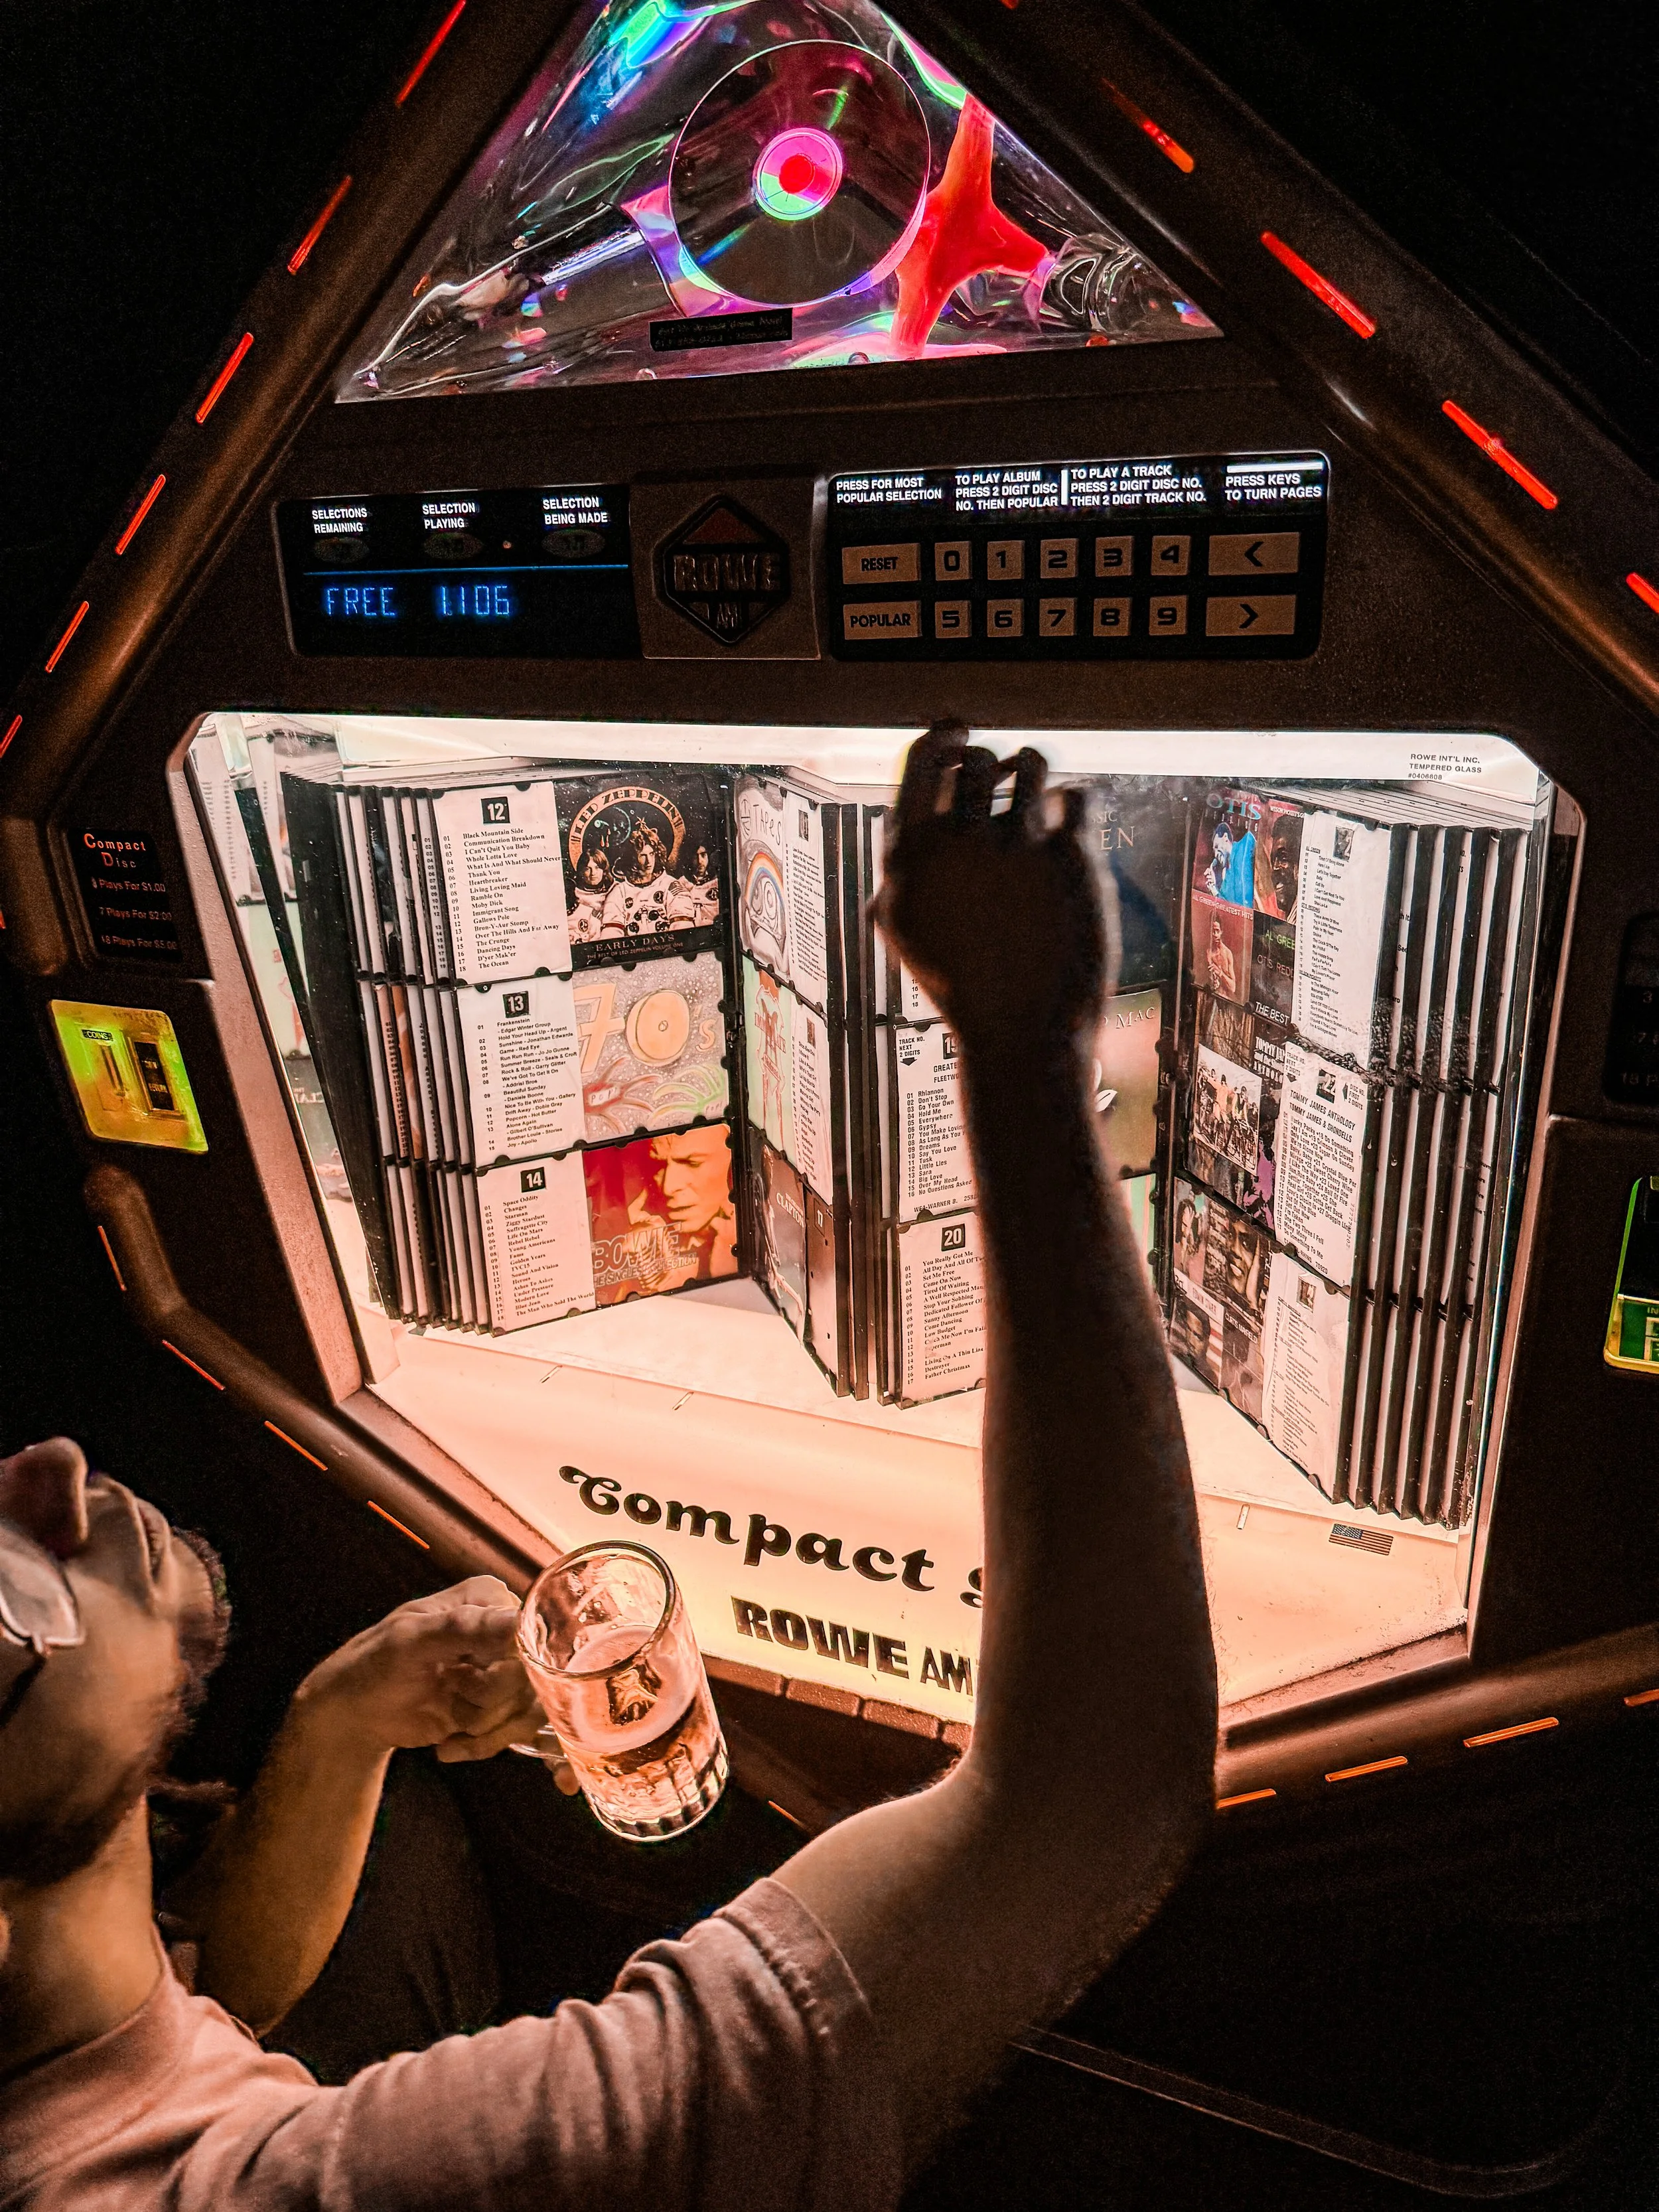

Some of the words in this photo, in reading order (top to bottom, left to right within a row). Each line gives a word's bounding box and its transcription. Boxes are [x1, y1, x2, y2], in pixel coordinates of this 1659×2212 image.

[956, 475, 970, 485] TO
[973, 473, 999, 484] PLAY
[1003, 471, 1041, 482] ALBUM
[1071, 469, 1086, 479] TO
[1090, 467, 1118, 479] PLAY
[1121, 467, 1130, 477] A
[1133, 465, 1172, 477] TRACK
[1226, 475, 1265, 486] PRESS
[1268, 474, 1301, 485] KEYS
[837, 480, 869, 490] PRESS
[872, 479, 892, 489] FOR
[895, 478, 924, 488] MOST
[956, 487, 989, 498] PRESS
[992, 486, 999, 496] 2
[1001, 484, 1029, 496] DIGIT
[1033, 483, 1057, 494] DISC
[1071, 482, 1107, 492] PRESS
[1110, 481, 1117, 491] 2
[1119, 480, 1149, 490] DIGIT
[1153, 479, 1179, 489] DISC
[1183, 478, 1202, 488] NO.
[837, 492, 883, 503] POPULAR
[886, 490, 942, 501] SELECTION
[1070, 496, 1100, 506] THEN
[1102, 495, 1110, 505] 2
[1112, 494, 1141, 504] DIGIT
[1145, 492, 1184, 503] TRACK
[1187, 491, 1206, 502] NO.
[1225, 490, 1242, 500] TO
[1244, 488, 1277, 499] TURN
[1280, 486, 1322, 498] PAGES
[423, 503, 476, 514] SELECTION
[543, 496, 599, 510] SELECTION
[956, 500, 974, 511] NO.
[977, 499, 1004, 510] THEN
[1007, 496, 1058, 508] POPULAR
[312, 508, 367, 520] SELECTIONS
[545, 512, 575, 525] BEING
[578, 512, 608, 524] MADE
[314, 522, 363, 534] REMAINING
[425, 518, 465, 529] PLAYING
[944, 550, 960, 571] 0
[996, 551, 1006, 568] 1
[1048, 550, 1068, 569] 2
[1104, 548, 1123, 567] 3
[1161, 545, 1179, 564] 4
[861, 557, 898, 571] RESET
[326, 587, 396, 616] FREE
[850, 613, 910, 628] POPULAR
[942, 611, 959, 628] 5
[995, 611, 1013, 628] 6
[1047, 609, 1066, 627] 7
[1100, 609, 1120, 625] 8
[1157, 607, 1177, 625] 9
[488, 803, 505, 821] 12
[602, 789, 679, 820] ZEPPELIN
[1206, 793, 1261, 820] OTIS
[84, 833, 146, 851] Compact
[101, 852, 136, 867] Disc
[99, 878, 123, 891] Plays
[124, 881, 139, 890] For
[141, 882, 165, 892] $1.00
[106, 907, 130, 919] Plays
[132, 910, 147, 919] For
[1242, 911, 1253, 921] HITS
[597, 940, 636, 952] EARLY
[643, 934, 674, 945] DAYS
[1265, 930, 1273, 940] AL
[1277, 934, 1295, 950] GREE
[1258, 954, 1273, 968] OTIS
[508, 996, 524, 1012] 13
[1256, 1001, 1269, 1016] THE
[1270, 1009, 1290, 1025] BEST
[87, 1031, 108, 1039] COINS
[1256, 1037, 1275, 1057] TOMMY
[1276, 1047, 1285, 1062] JA
[934, 1063, 957, 1072] GREATE
[1254, 1061, 1283, 1084] ANTHOLO
[1290, 1090, 1309, 1105] TOMMY
[1309, 1101, 1326, 1114] JAMES
[1327, 1110, 1355, 1131] ANTHOLOGY
[1289, 1102, 1305, 1116] TOMMY
[1306, 1112, 1321, 1125] JAMES
[1327, 1124, 1352, 1142] SHONDELLS
[527, 1172, 543, 1188] 14
[776, 1193, 804, 1228] CLAPTON
[944, 1228, 962, 1246] 20
[593, 1222, 682, 1276] BOWIE
[607, 1268, 642, 1284] SINGLES
[944, 1364, 970, 1374] Christmas
[559, 1465, 935, 1592] Compact
[731, 1595, 910, 1680] ROWE
[920, 1646, 974, 1696] AM
